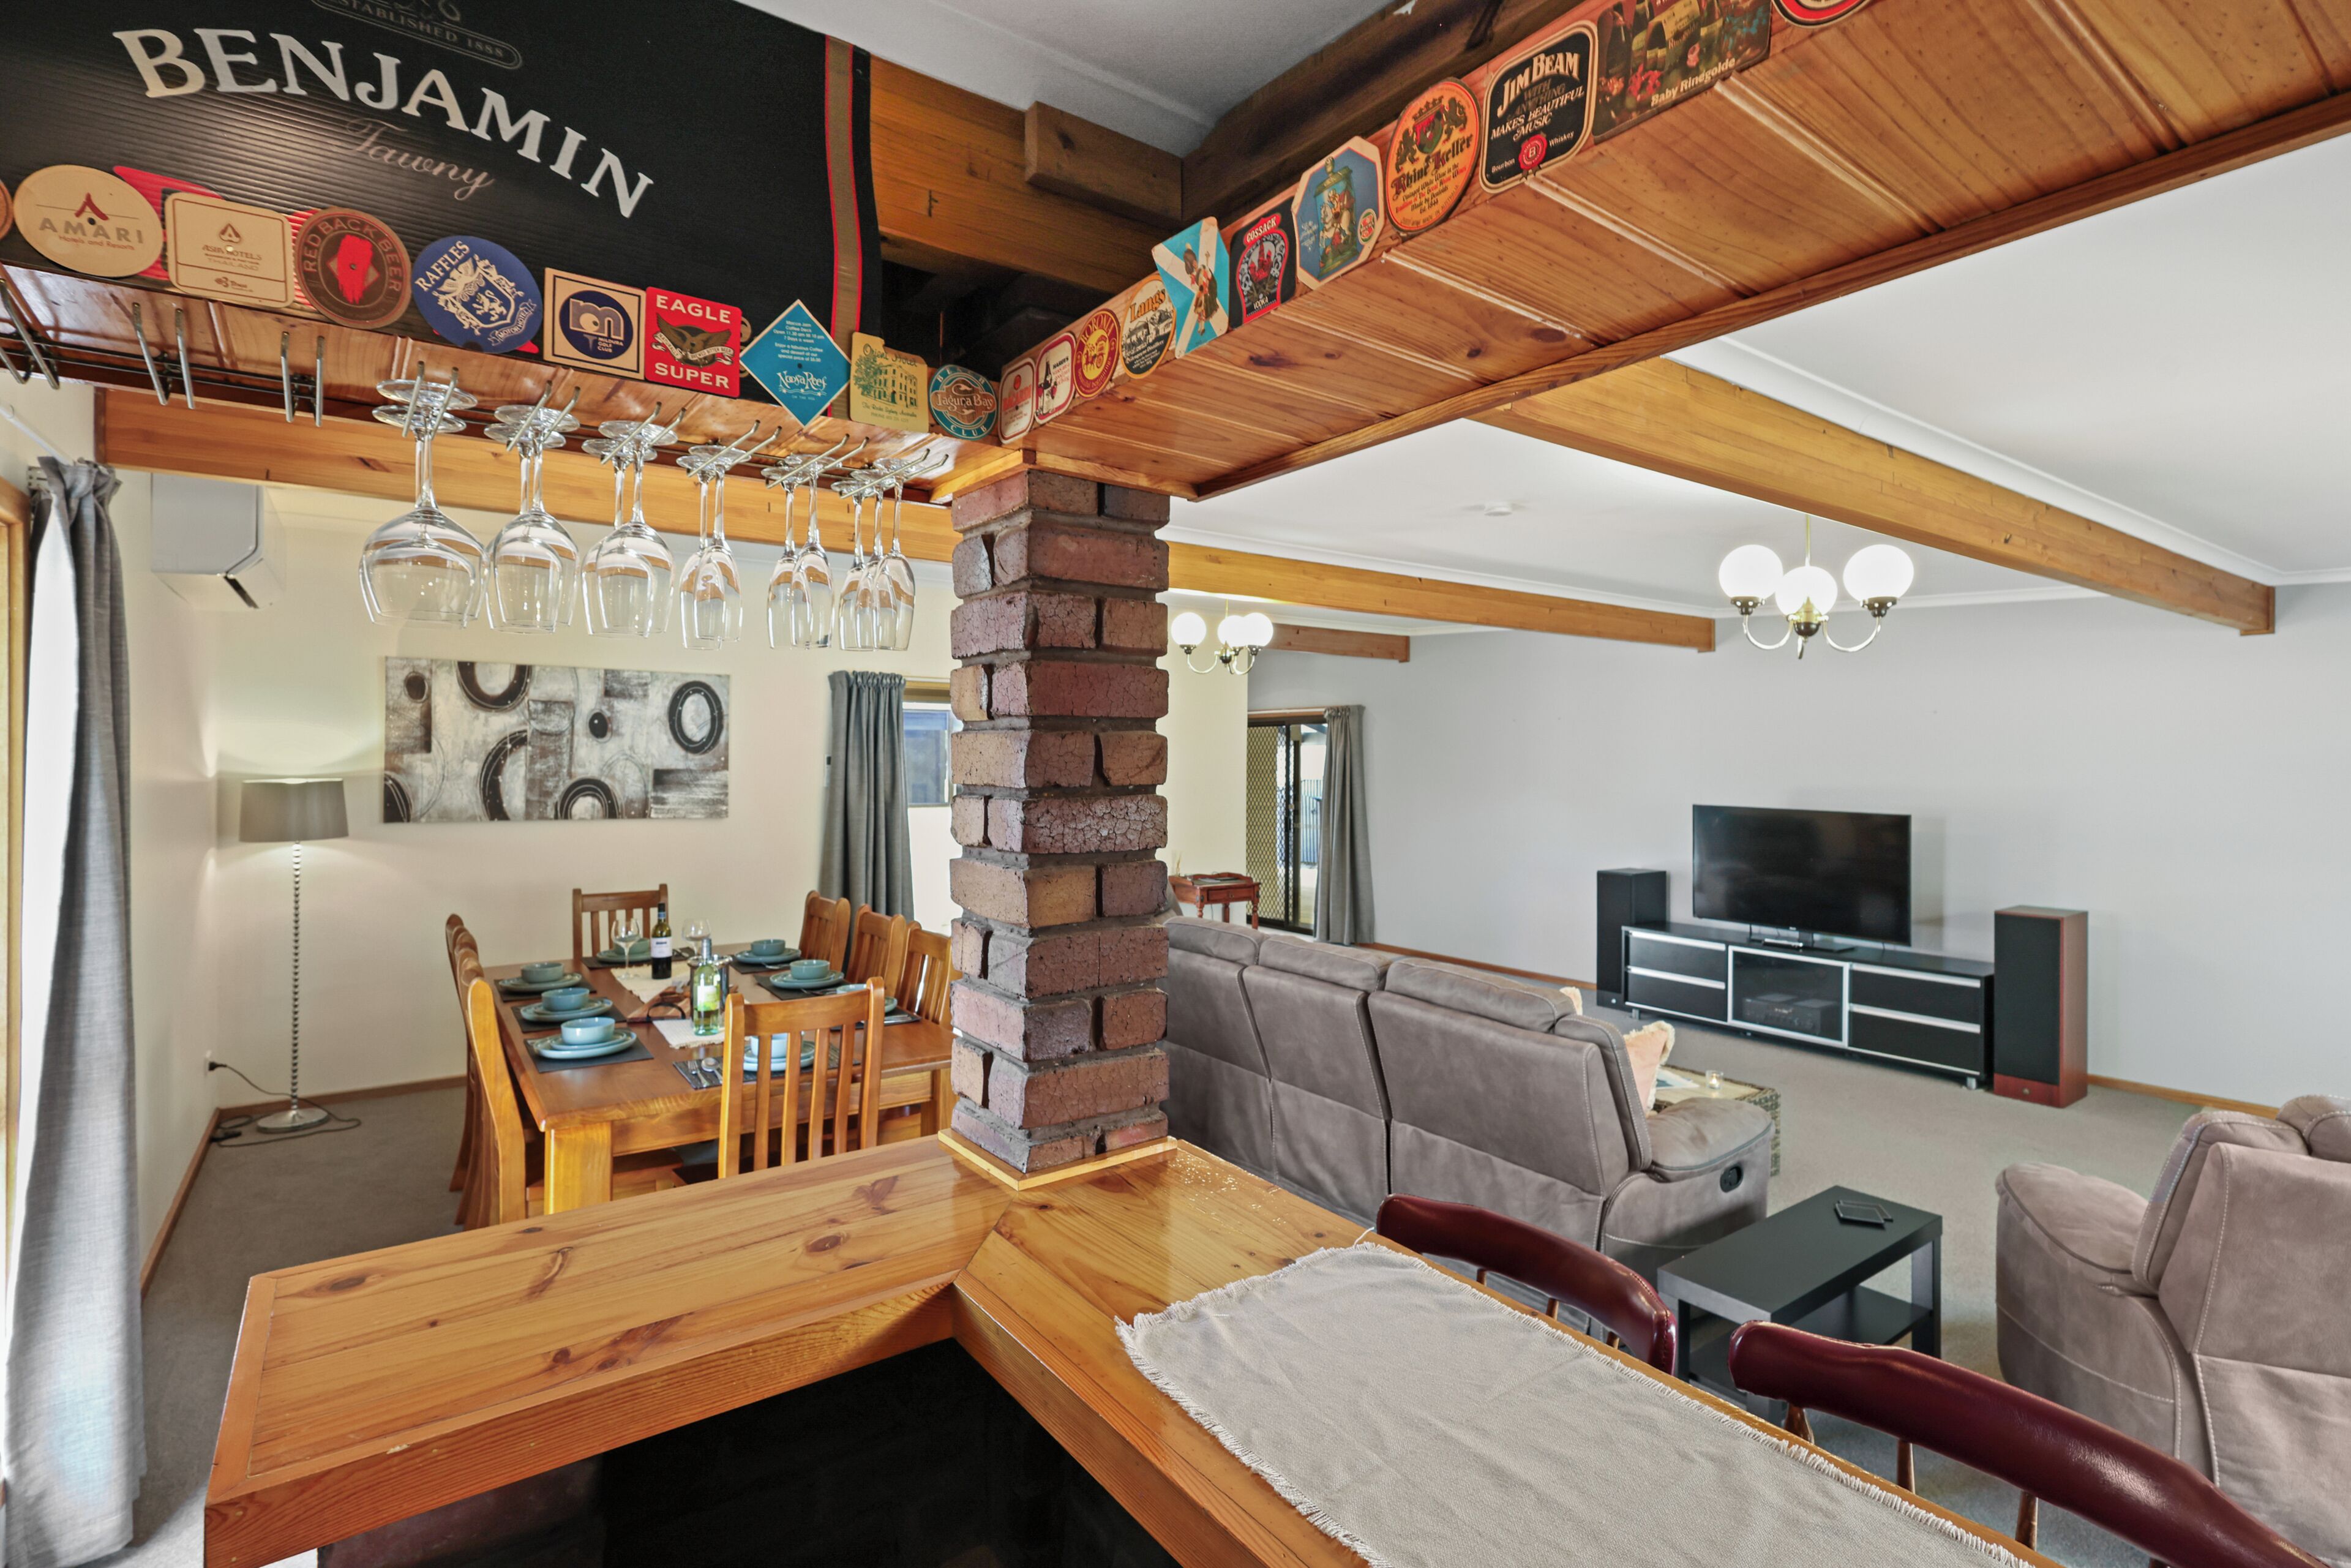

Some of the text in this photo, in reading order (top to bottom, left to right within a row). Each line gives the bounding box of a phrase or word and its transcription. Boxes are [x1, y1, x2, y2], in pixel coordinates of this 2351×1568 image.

[329, 0, 504, 59] STABLISHED 1888
[1497, 51, 1580, 118] JIM BEAM
[1524, 78, 1551, 100] WITH
[1651, 84, 1678, 107] Baby
[112, 28, 654, 219] BENJAMIN
[1491, 86, 1585, 140] MAKES BEAUTIFUL
[1513, 113, 1553, 142] MUSIC
[346, 117, 495, 201] Tawny
[1491, 130, 1575, 174] Bourbon Whiskey
[1391, 154, 1431, 202] Rhine
[1431, 133, 1473, 176] Keller
[39, 217, 144, 244] AMARI
[59, 234, 85, 245] Hotels
[107, 242, 135, 251] Resorts
[1246, 216, 1277, 243] COSSACK
[208, 257, 259, 271] THAILAND
[378, 238, 403, 292] BEER
[414, 240, 470, 292] RAFFLES
[656, 294, 731, 324] EAGLE
[1253, 296, 1269, 310] VODKA
[498, 306, 529, 340] MOTOR HOTEL
[598, 337, 624, 347] MILDURA
[863, 343, 918, 367] Orient Hotel
[654, 362, 730, 389] SUPER
[776, 370, 827, 391] Noosa Reef
[973, 394, 994, 409] Bay
[950, 425, 988, 437] CLUB
